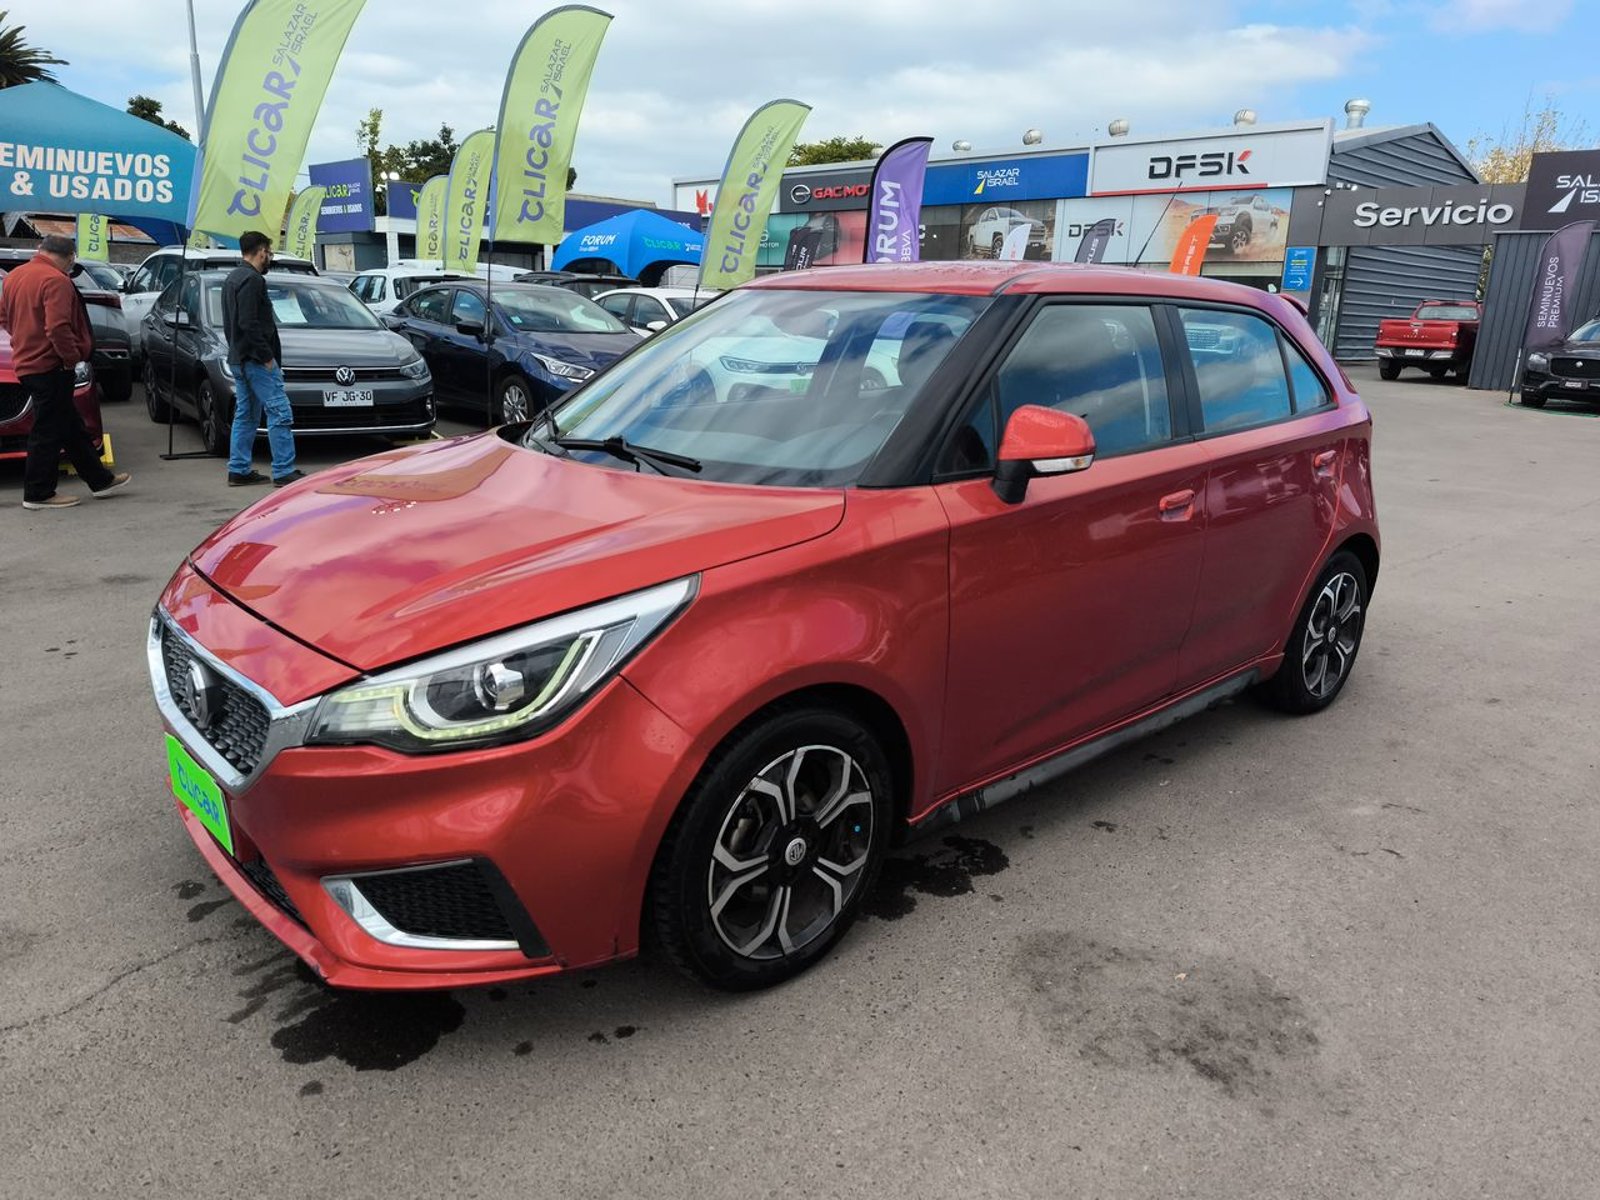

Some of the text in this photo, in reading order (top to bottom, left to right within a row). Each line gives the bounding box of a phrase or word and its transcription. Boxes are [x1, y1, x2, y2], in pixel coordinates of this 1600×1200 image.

[272, 4, 307, 67] SALAZAR
[291, 11, 318, 55] ISRAEL
[540, 38, 564, 93] SALAZAR
[554, 43, 571, 82] ISRAEL
[976, 168, 1020, 180] SALAZAR
[1148, 149, 1253, 179] DFSK
[10, 171, 173, 203] & USADOS
[812, 184, 870, 199] GAC MO
[986, 177, 1019, 187] ISRAEL
[1555, 174, 1600, 189] SAL
[1579, 190, 1600, 204] IS
[1353, 198, 1514, 227] Servicio
[580, 234, 617, 246] FORUM
[1536, 256, 1559, 328] SEMINUEVOS
[1547, 277, 1564, 328] PREMIUM
[325, 391, 338, 402] VF
